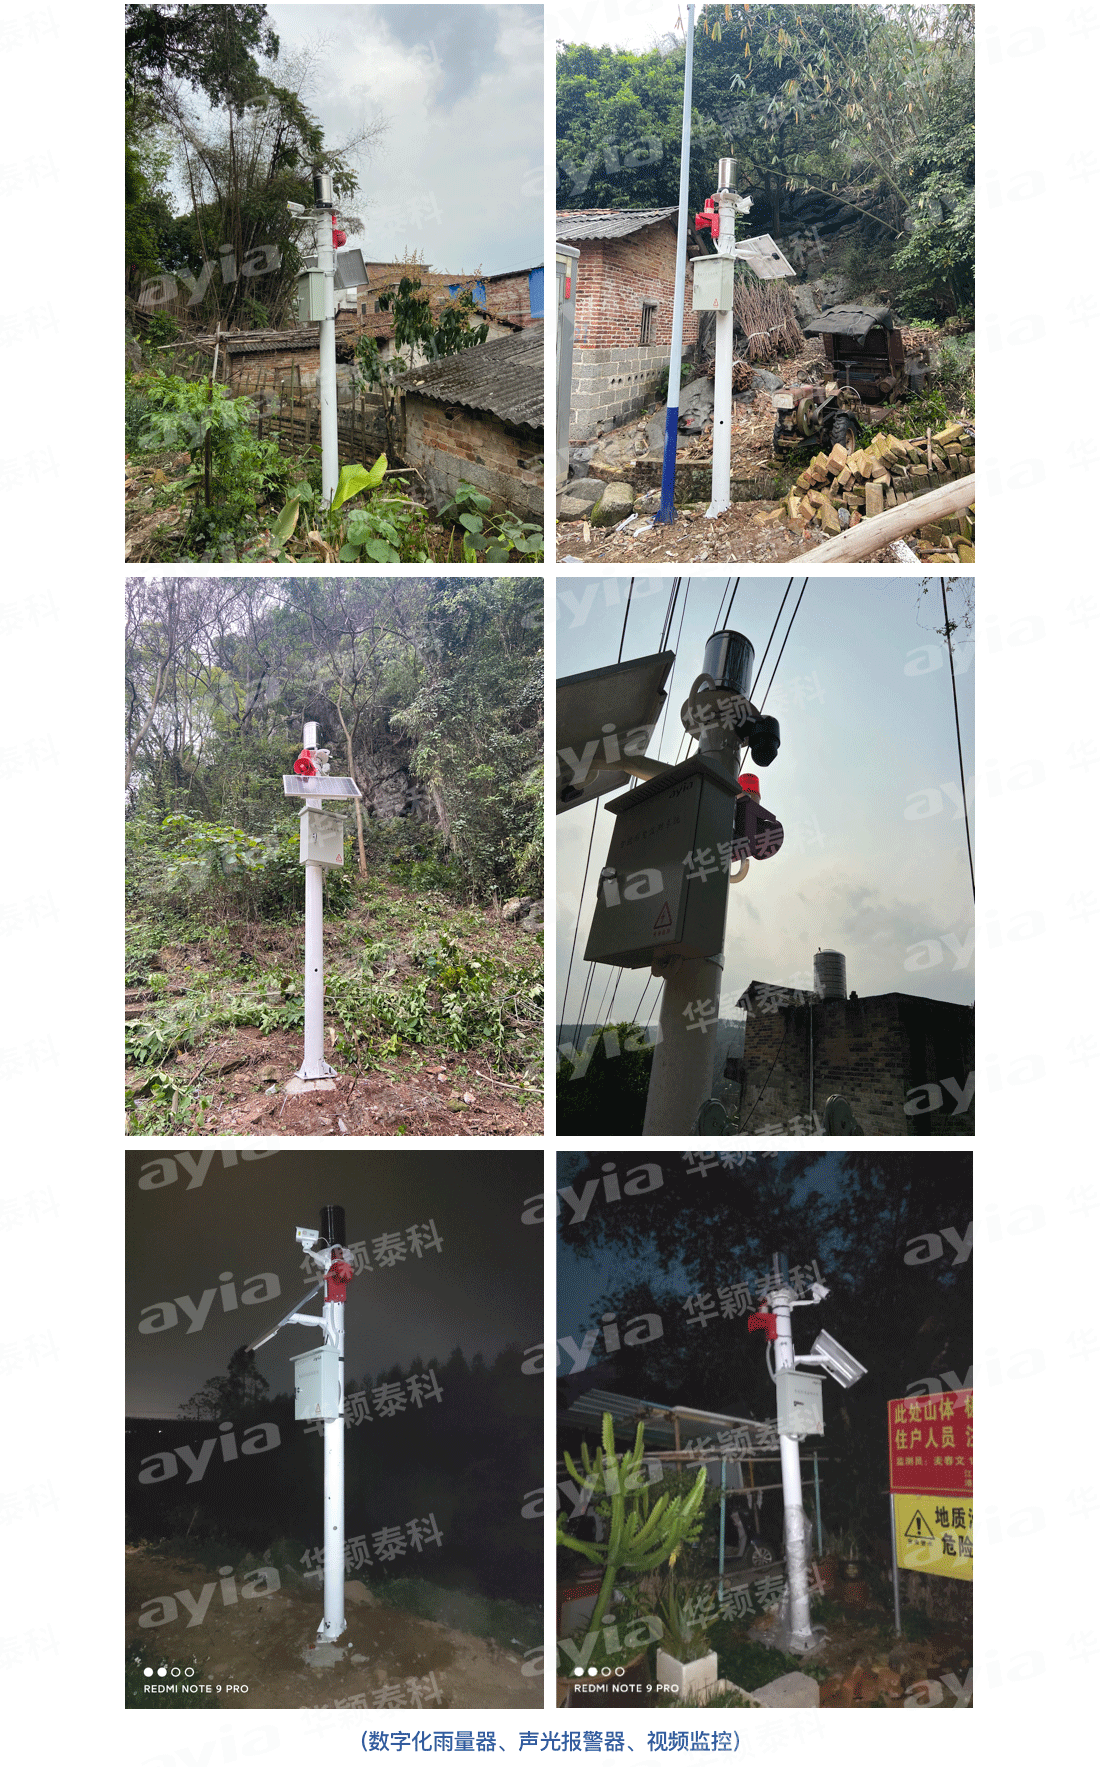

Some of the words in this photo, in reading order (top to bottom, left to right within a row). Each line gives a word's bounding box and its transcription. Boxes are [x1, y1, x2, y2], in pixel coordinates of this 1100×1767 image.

[894, 1397, 955, 1423] 此处山体
[895, 1426, 955, 1450] 住户人员
[942, 1533, 973, 1558] 危险
